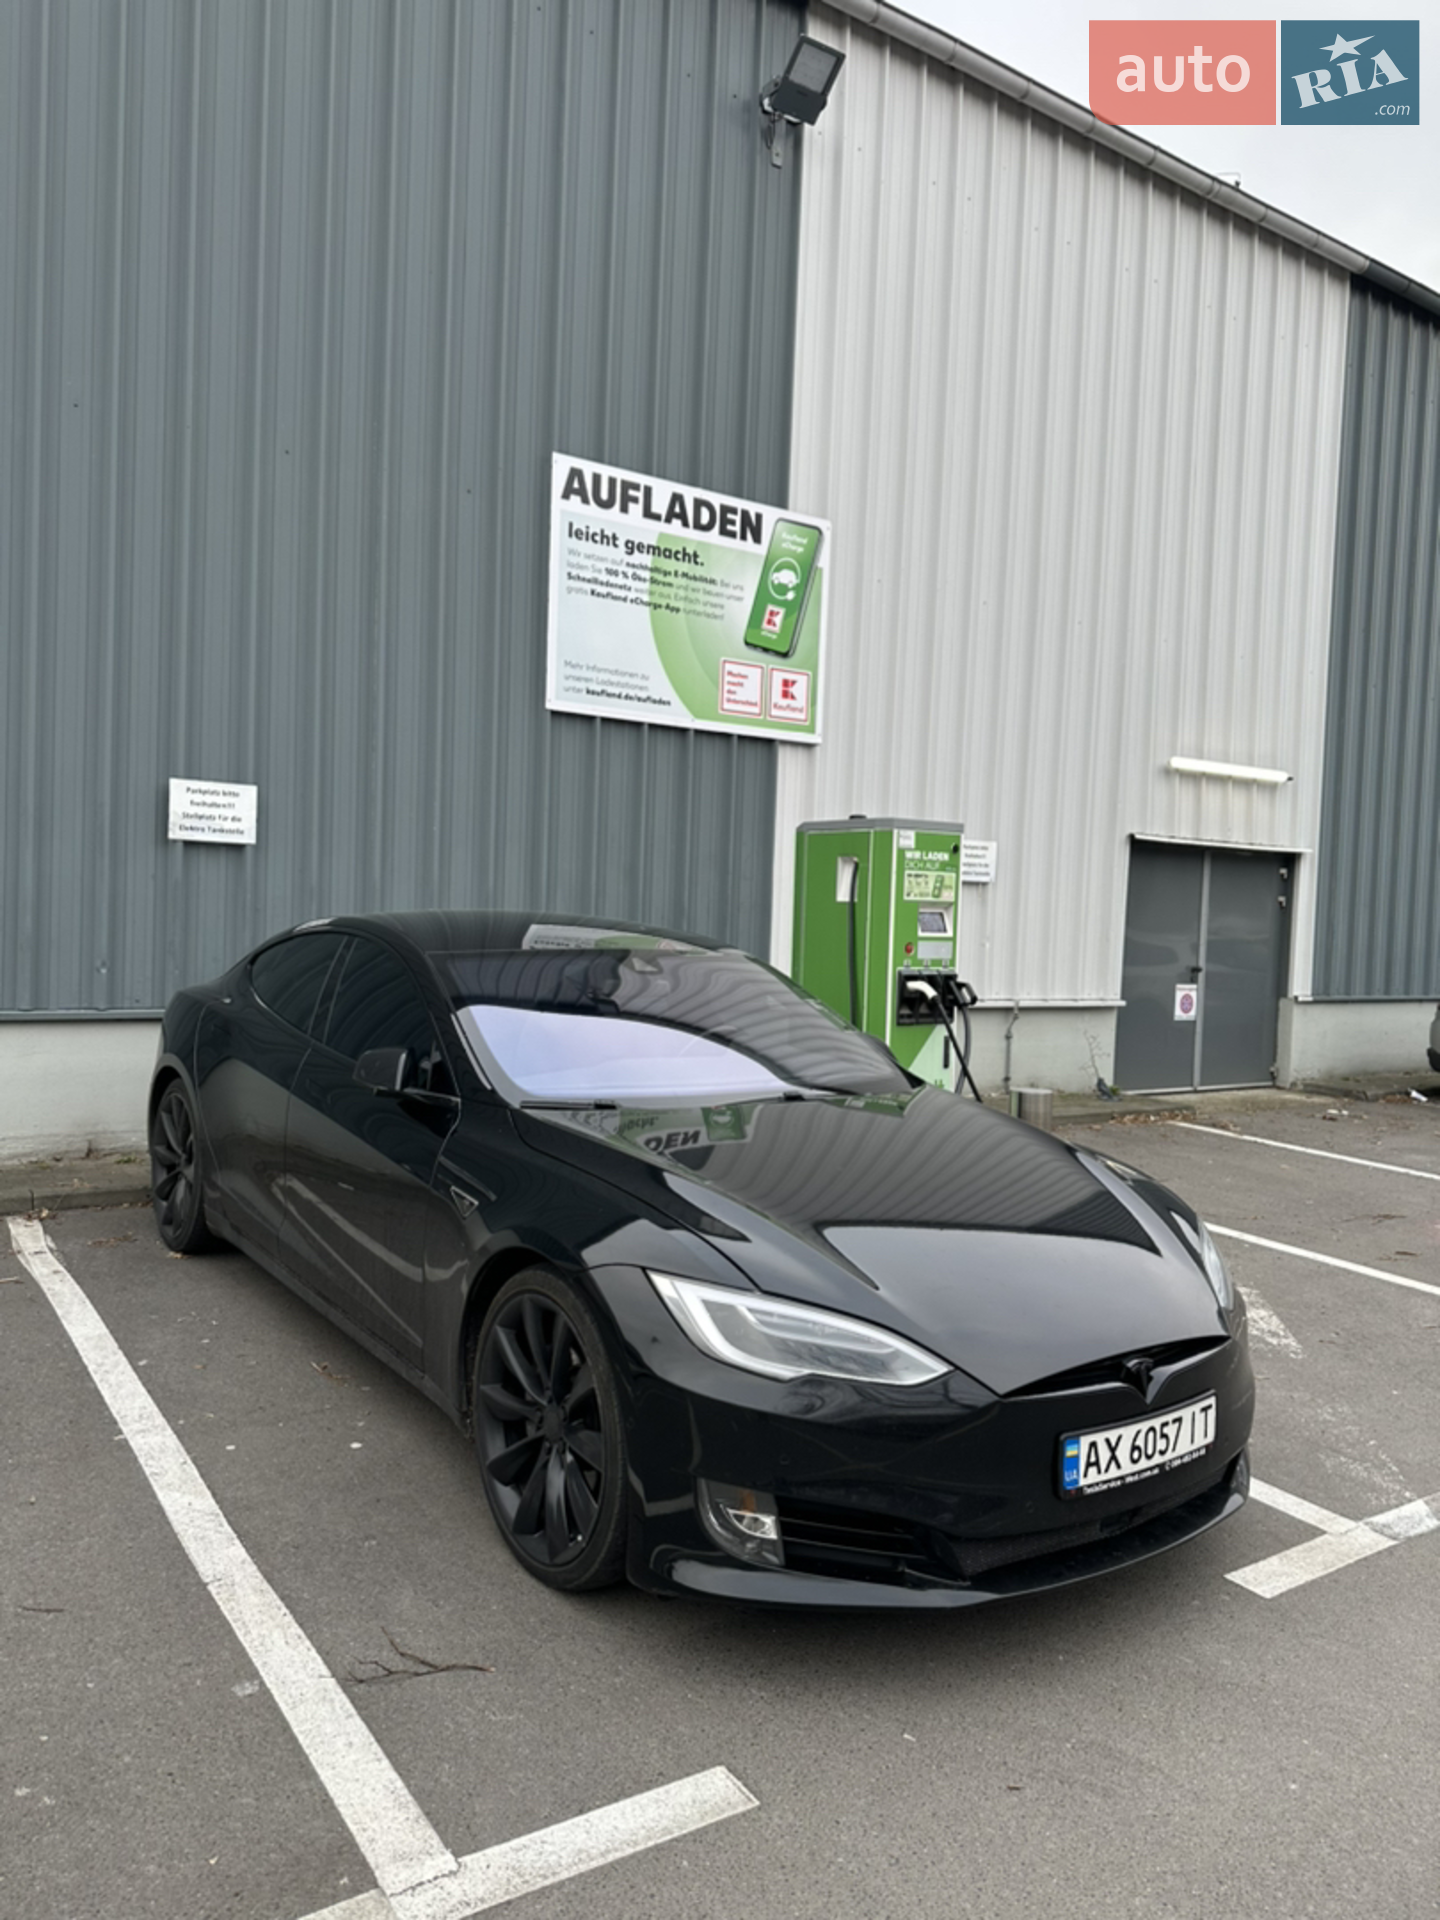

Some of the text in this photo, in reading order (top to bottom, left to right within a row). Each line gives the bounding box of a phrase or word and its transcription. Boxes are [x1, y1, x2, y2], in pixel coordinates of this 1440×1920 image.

[561, 466, 763, 545] AUFLADEN
[567, 521, 705, 567] leicht gemacht.
[604, 567, 620, 578] 100
[590, 588, 628, 604] Kaufland
[563, 659, 585, 671] Mehr
[586, 663, 639, 679] Informationen
[595, 676, 649, 692] Ladestationen
[904, 850, 950, 862] WIR LADEN
[1083, 1433, 1123, 1479] AX
[1129, 1416, 1183, 1466] 6057
[1190, 1403, 1213, 1445] IT
[1065, 1468, 1079, 1482] UA
